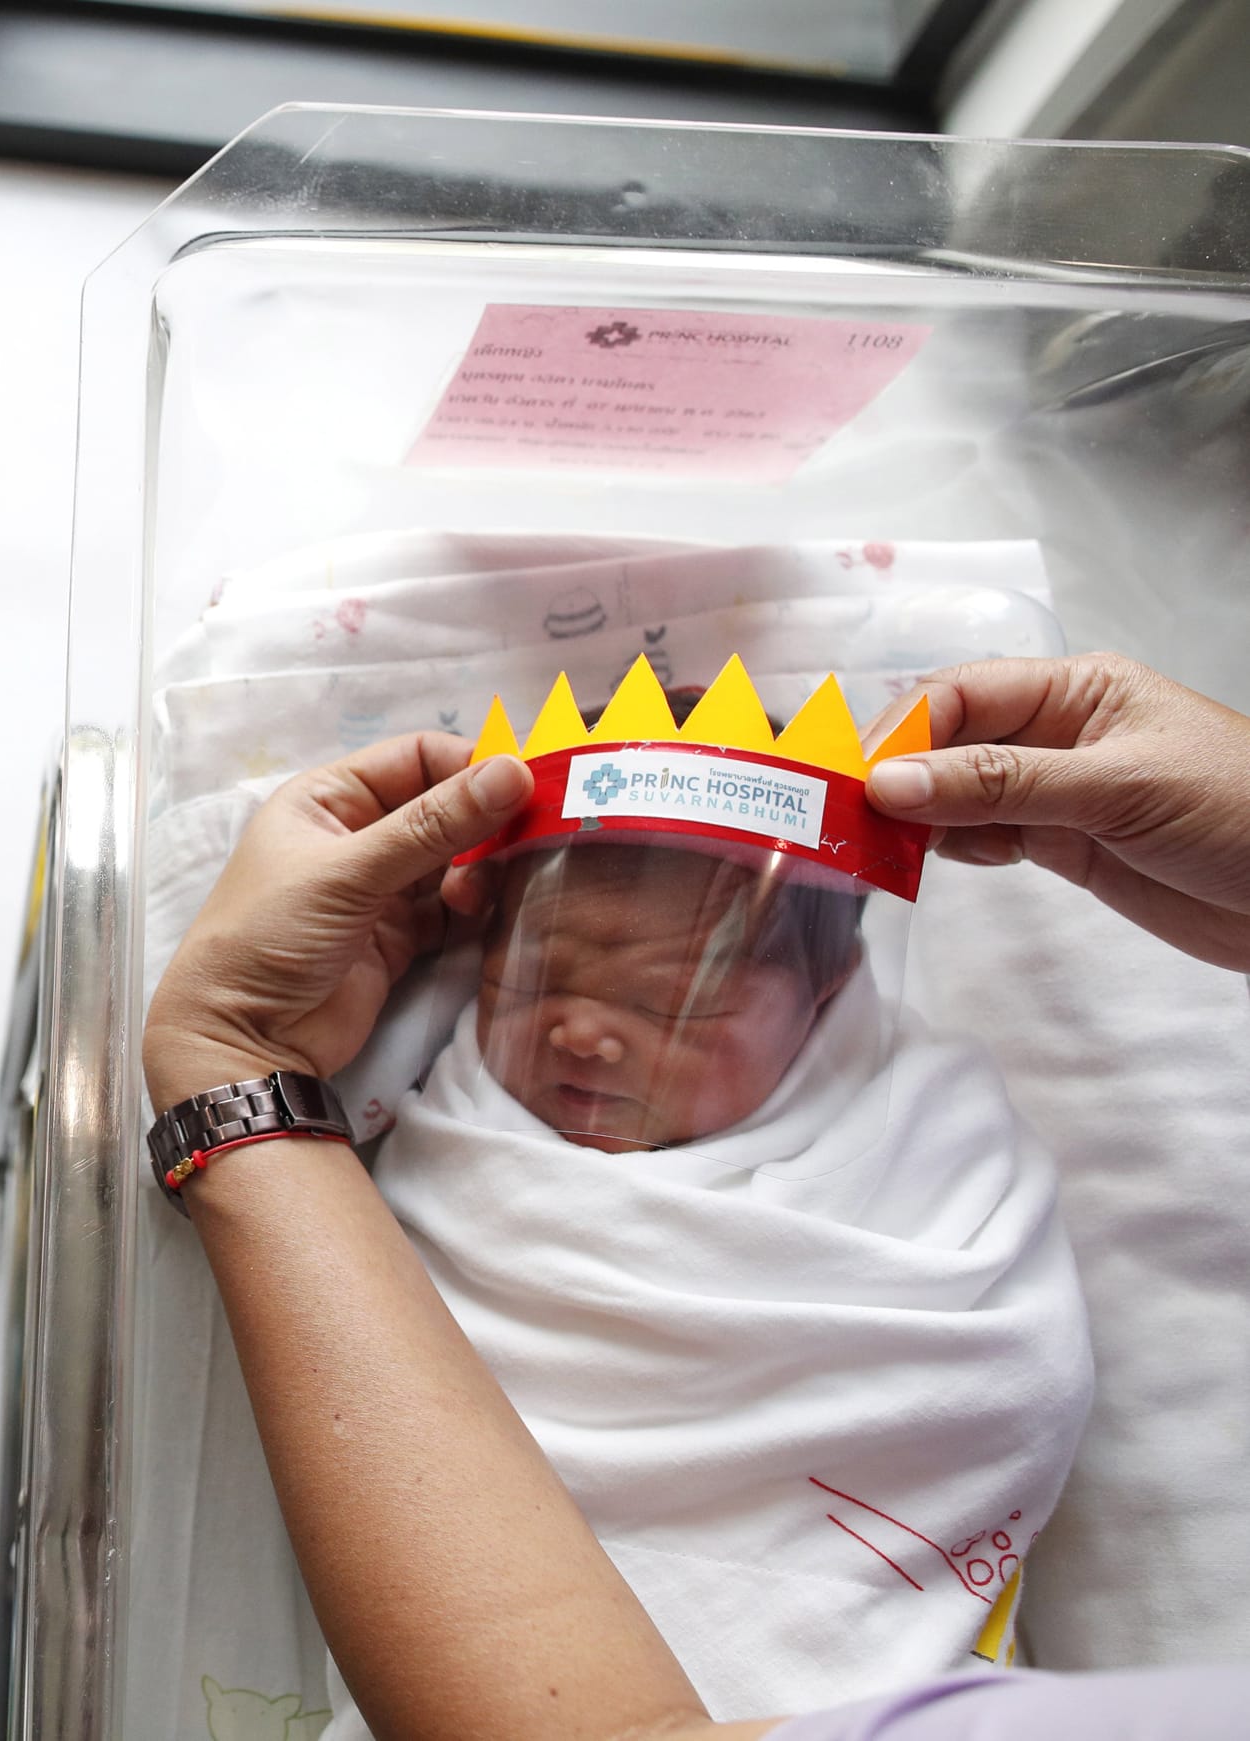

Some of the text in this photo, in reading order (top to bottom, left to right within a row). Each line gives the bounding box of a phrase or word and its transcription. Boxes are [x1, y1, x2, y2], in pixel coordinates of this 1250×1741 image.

[846, 332, 904, 350] 1108
[628, 789, 807, 829] SUVARNABHUMI
[706, 778, 808, 814] HOSPITAL
